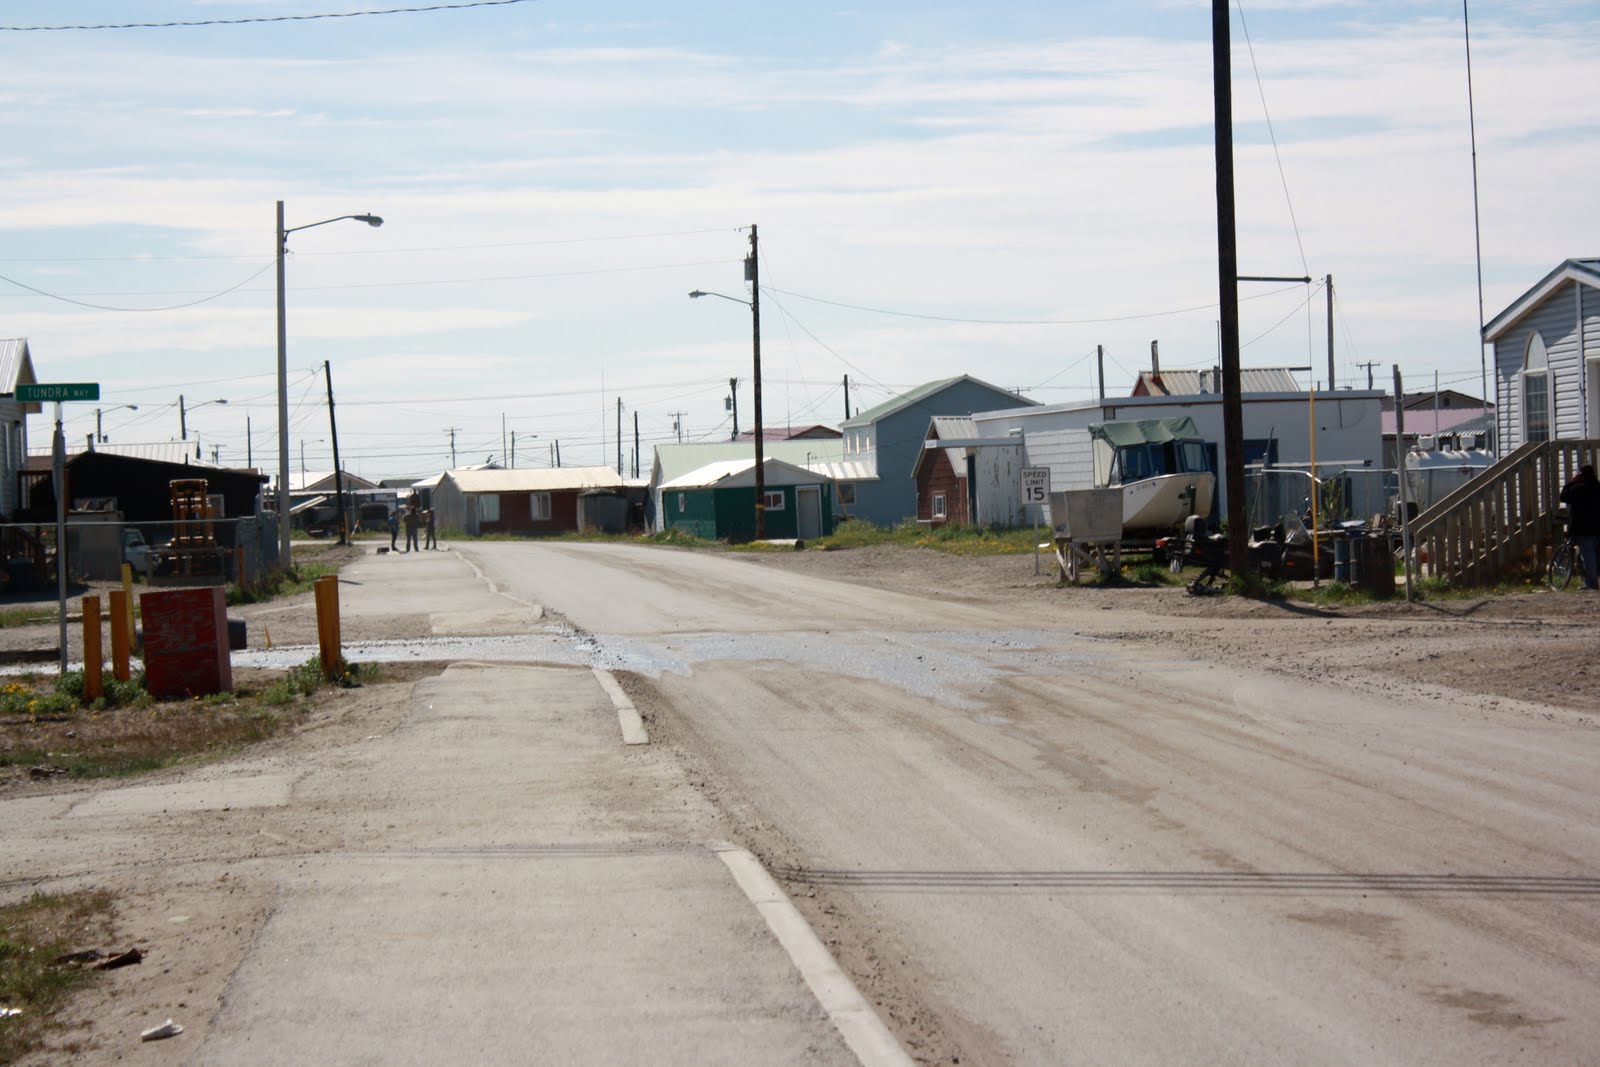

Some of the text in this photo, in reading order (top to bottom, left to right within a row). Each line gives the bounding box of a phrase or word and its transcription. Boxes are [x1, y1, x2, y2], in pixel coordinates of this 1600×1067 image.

[27, 387, 89, 399] TUNDRA WAY
[1026, 487, 1045, 501] 15
